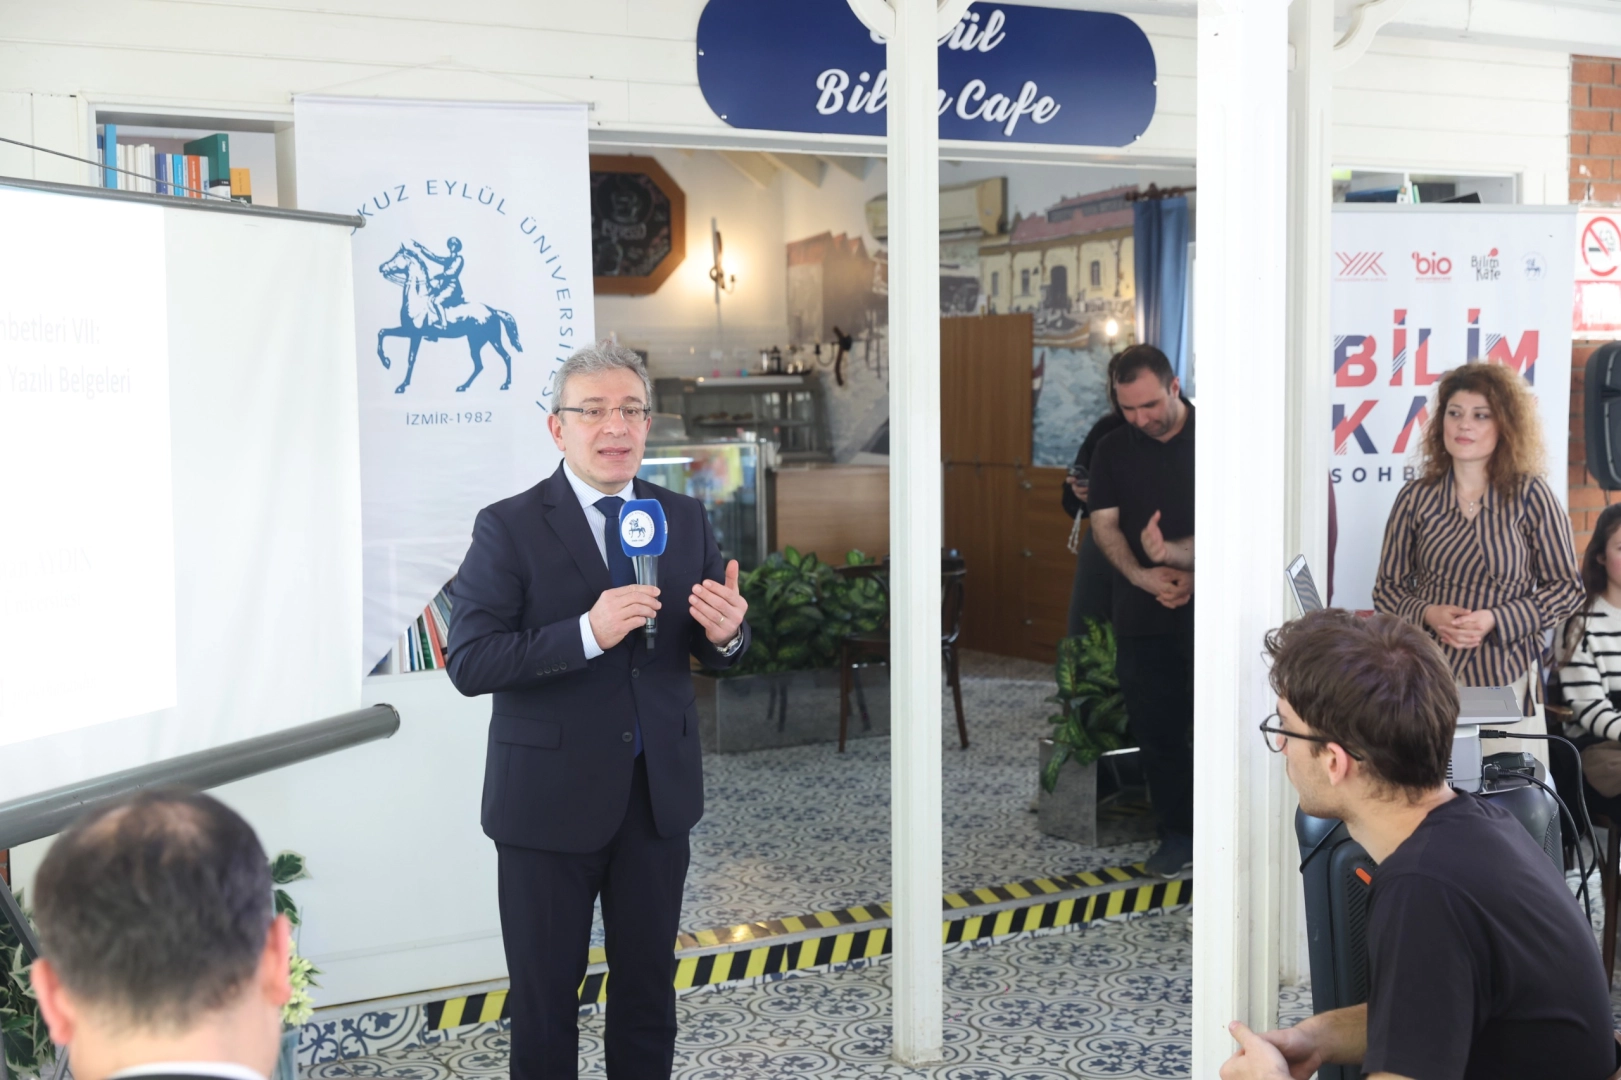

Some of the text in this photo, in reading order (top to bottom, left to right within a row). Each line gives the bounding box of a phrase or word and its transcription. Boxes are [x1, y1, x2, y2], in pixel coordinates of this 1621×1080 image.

[815, 68, 1061, 137] Bil Cafe
[350, 184, 409, 236] KUZ
[426, 179, 506, 215] EYLÜL
[1413, 251, 1452, 275] bio
[72, 316, 100, 344] VII:
[1333, 308, 1539, 388] BİLİM
[7, 363, 53, 393] Yazılı
[58, 364, 131, 401] Belgeleri
[405, 411, 493, 426] İZMİR-1982
